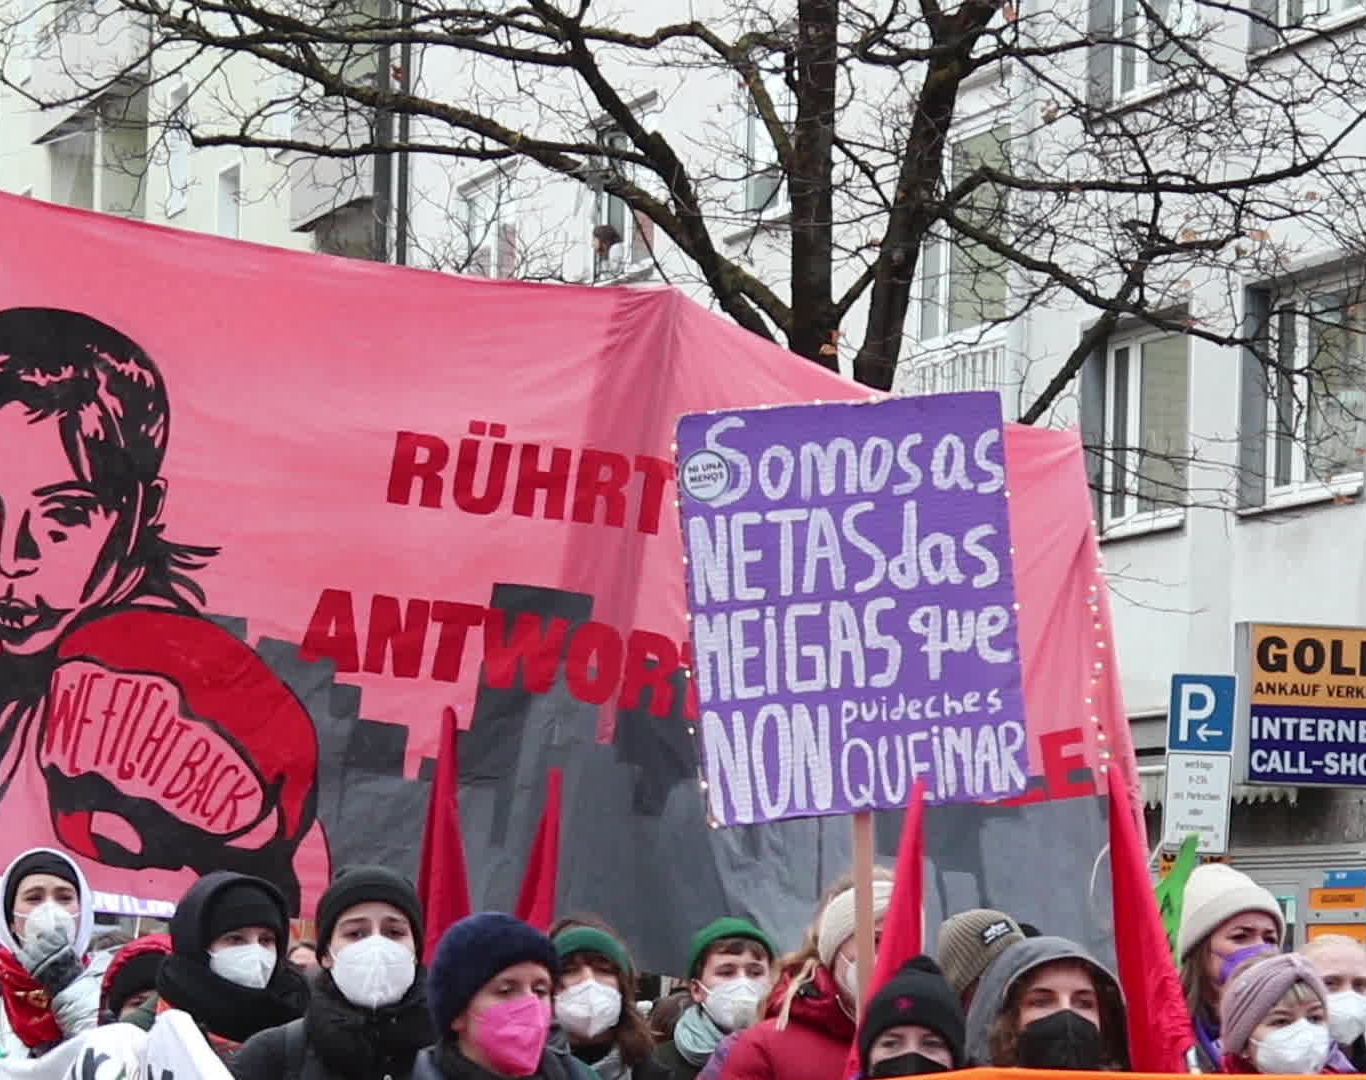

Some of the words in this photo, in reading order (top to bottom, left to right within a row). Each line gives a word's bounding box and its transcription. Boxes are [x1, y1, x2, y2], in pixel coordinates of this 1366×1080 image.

[387, 420, 678, 536] RÜHRT
[702, 461, 724, 472] UNA
[705, 415, 924, 508] Somos
[930, 428, 1005, 495] as
[688, 501, 888, 606] NETAS
[887, 500, 1001, 591] das
[298, 587, 699, 722] ANTWOR
[907, 604, 1016, 681] que
[1253, 681, 1322, 697] ANKAUF
[44, 669, 106, 776] WE
[161, 737, 258, 831] BACK
[1178, 683, 1216, 742] P
[701, 702, 834, 826] NON
